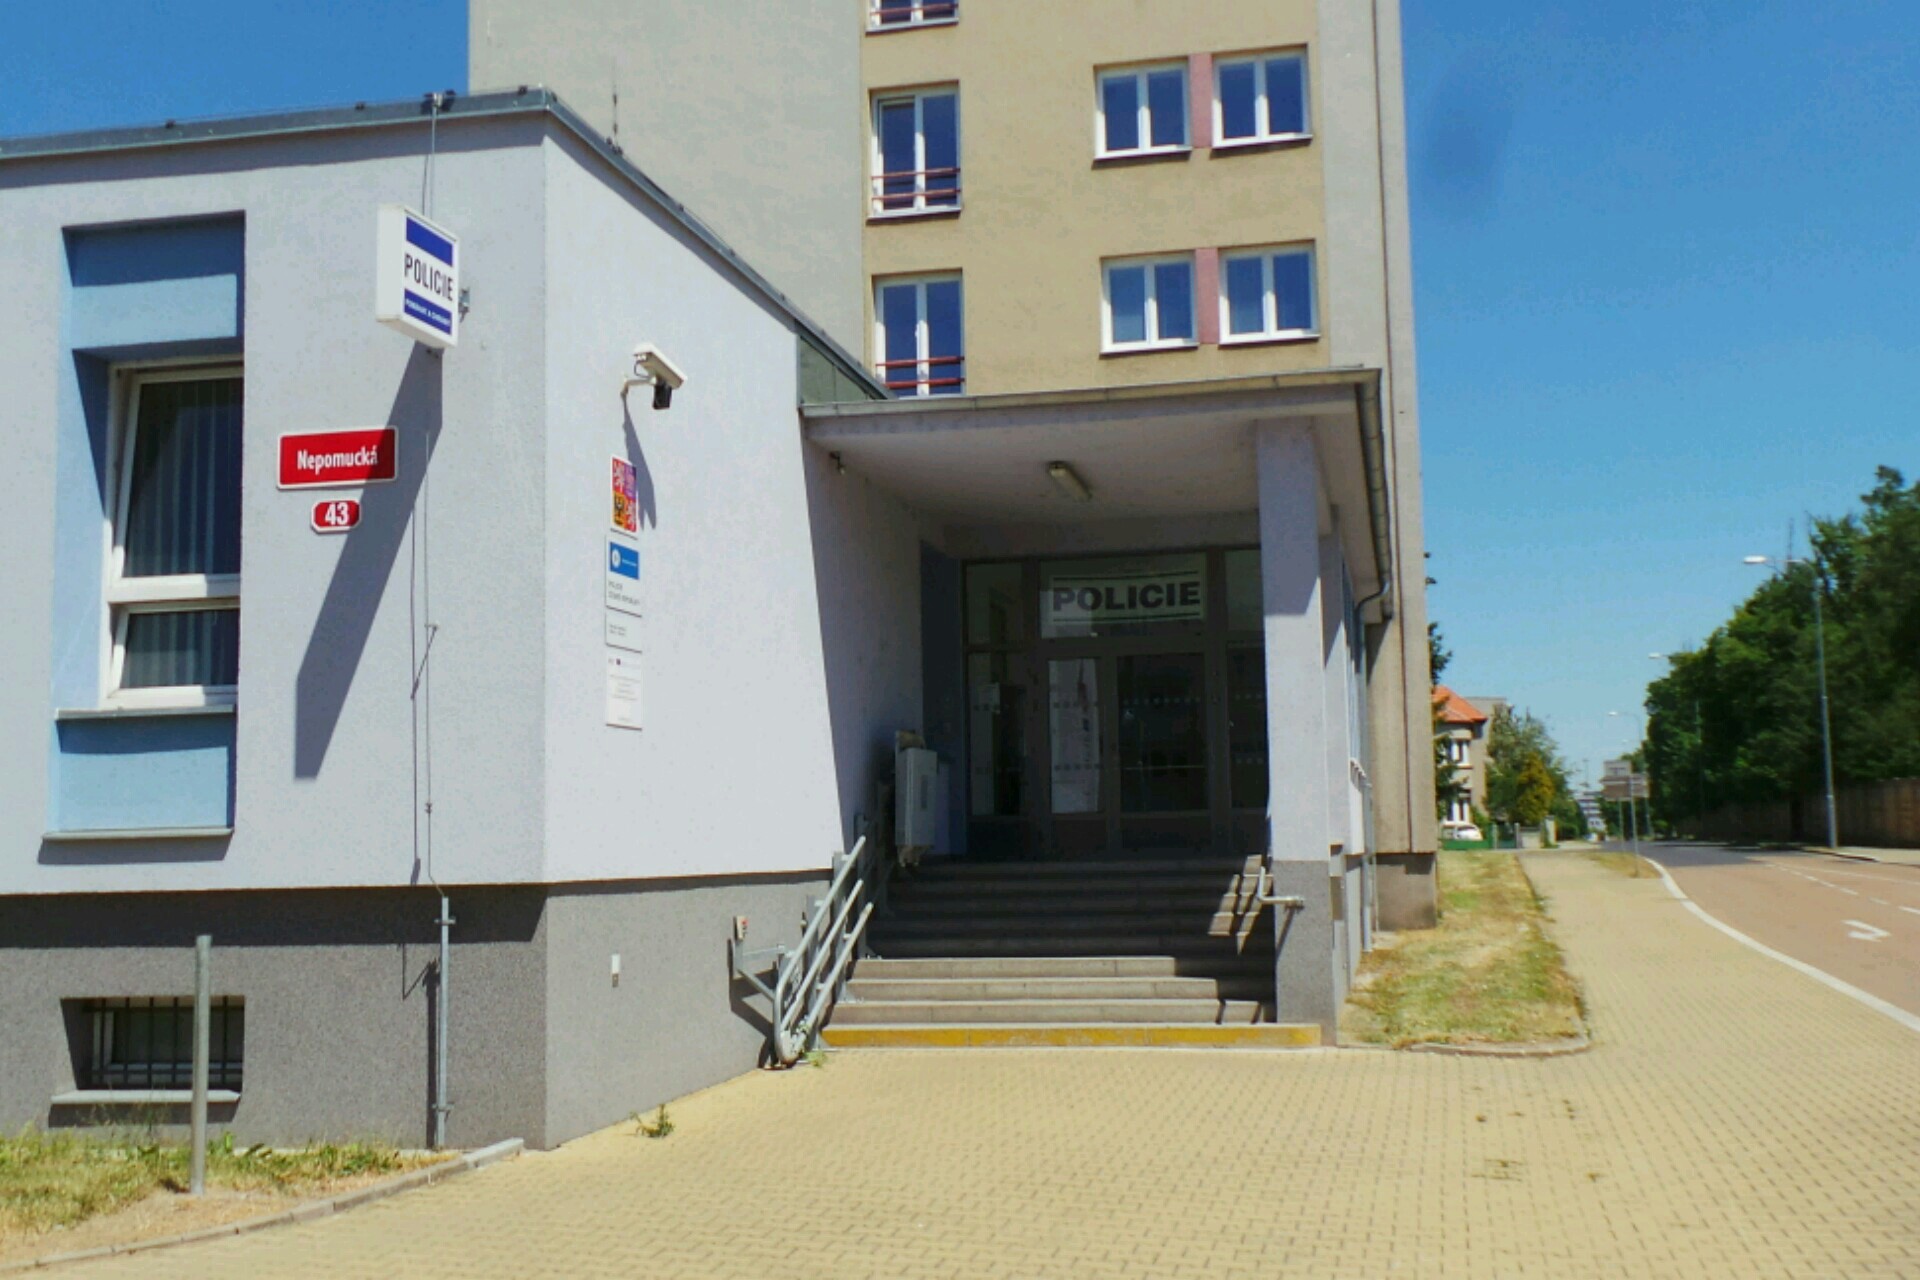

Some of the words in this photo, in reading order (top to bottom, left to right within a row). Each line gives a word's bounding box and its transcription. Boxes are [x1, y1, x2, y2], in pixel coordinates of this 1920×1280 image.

[404, 253, 454, 301] POLICIE
[297, 445, 378, 475] Nepomucká
[325, 502, 350, 526] 43
[1053, 581, 1201, 612] POLICIE
